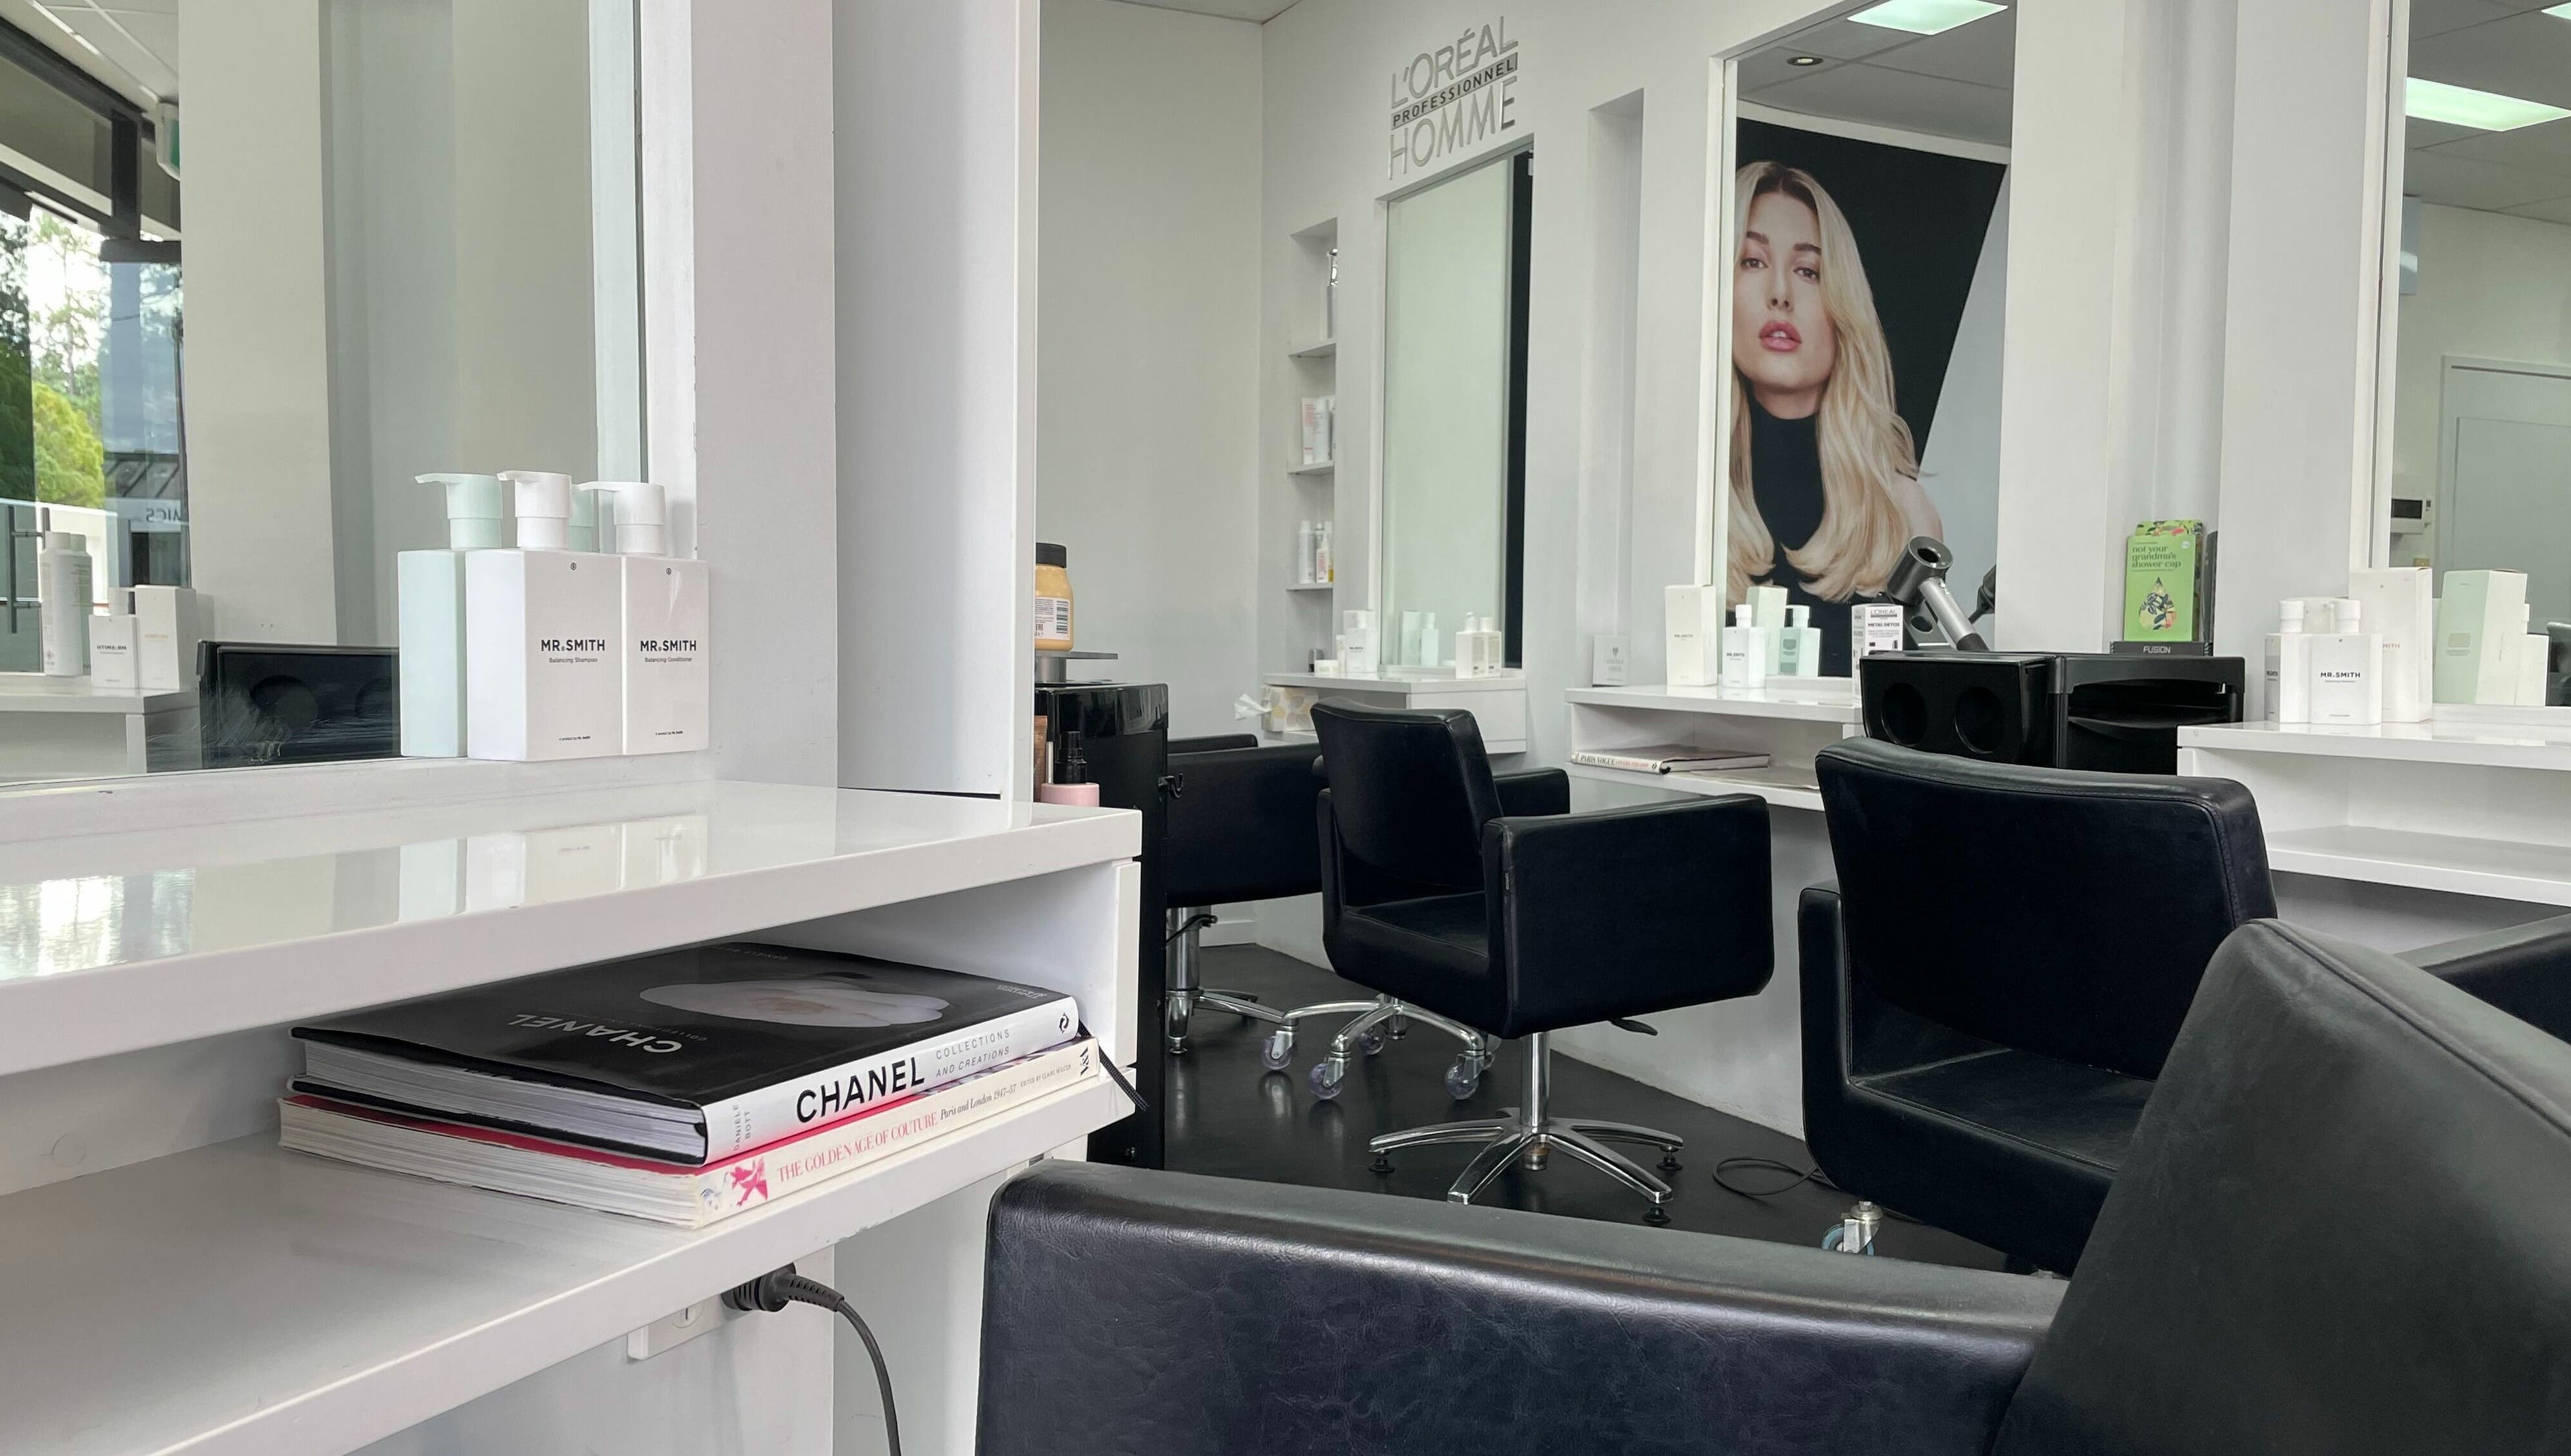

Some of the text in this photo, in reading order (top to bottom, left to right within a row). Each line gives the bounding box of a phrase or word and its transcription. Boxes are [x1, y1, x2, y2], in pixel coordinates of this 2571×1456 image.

[1391, 15, 1518, 109] L'ORÉAL
[1393, 59, 1514, 127] PROFESSIONNEL
[1388, 75, 1518, 181] HOMME
[2132, 552, 2176, 561] grandma's
[2149, 546, 2169, 554] your
[2142, 645, 2171, 654] FUSION
[1580, 754, 1596, 762] PARIS
[1597, 756, 1616, 766] VOGUE
[507, 1014, 682, 1053] CHANEL
[936, 1029, 1010, 1060] COLLECTIONS
[936, 1046, 1010, 1078] AND CREATIONS
[797, 1056, 925, 1123] CHANEL
[778, 1160, 803, 1183] THE
[804, 1141, 852, 1172] GOLDEN
[852, 1134, 875, 1155] AGE
[876, 1128, 890, 1145] OF
[891, 1111, 938, 1141] COUTURE
[940, 1107, 957, 1120] Paris
[957, 1100, 969, 1114] and
[970, 1093, 992, 1109] London
[1020, 1077, 1035, 1088] EDITED
[1042, 1069, 1055, 1080] CLAIRE
